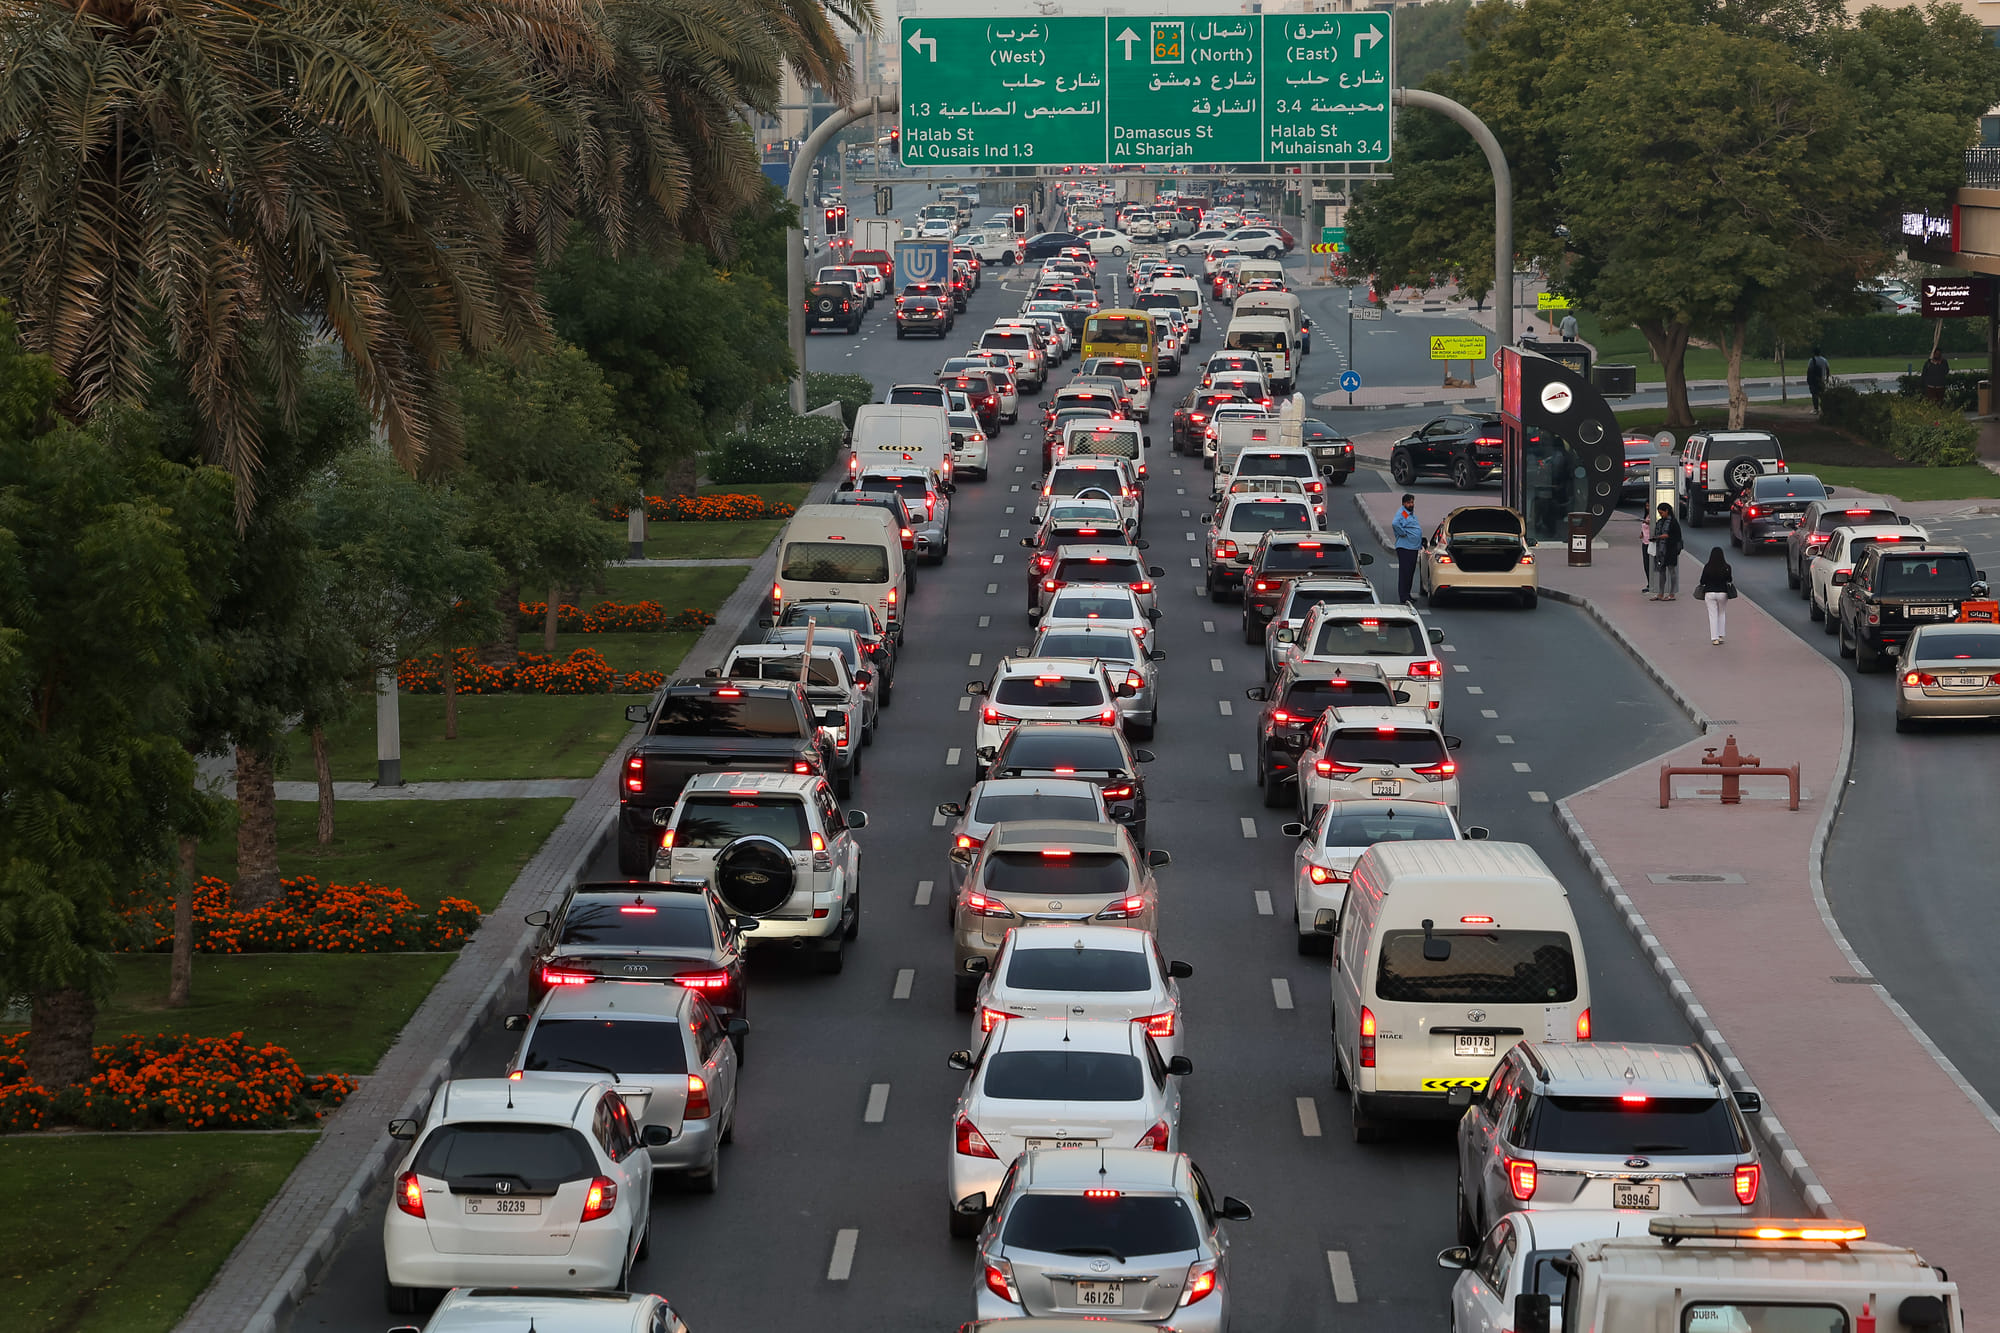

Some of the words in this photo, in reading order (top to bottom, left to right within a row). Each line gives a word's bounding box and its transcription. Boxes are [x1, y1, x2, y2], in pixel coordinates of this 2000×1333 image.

[1156, 30, 1166, 39] D
[990, 49, 1046, 67] (West)
[1155, 43, 1180, 58] 64
[1190, 47, 1253, 65] (North)
[1286, 46, 1338, 63] (East)
[1002, 73, 1046, 91] حلب
[1055, 72, 1101, 93] شارع
[1148, 72, 1202, 92] دمشق
[1210, 71, 1256, 91] شارع
[1286, 70, 1330, 89] حلب
[1339, 69, 1385, 89] شارع
[938, 100, 1017, 120] الصناعية
[1024, 99, 1101, 119] القصيص
[1191, 97, 1256, 118] الشارقة
[1310, 98, 1385, 116] محيصنة
[907, 127, 952, 142] Halab
[956, 127, 975, 141] St
[1114, 126, 1191, 139] Damascus
[1195, 125, 1214, 139] St
[1271, 124, 1316, 138] Halab
[1320, 124, 1338, 138] St
[907, 144, 924, 158] Al
[928, 143, 980, 159] Qusais
[985, 143, 1009, 157] Ind
[1114, 142, 1131, 156] Al
[1135, 141, 1193, 158] Sharjah
[1271, 140, 1352, 154] Muhaisnah
[1460, 1036, 1490, 1046] 60178
[1647, 1186, 1654, 1194] Z
[496, 1200, 526, 1212] 36239
[1621, 1194, 1650, 1206] 39946
[1108, 1283, 1121, 1291] AA
[1084, 1291, 1115, 1304] 46126
